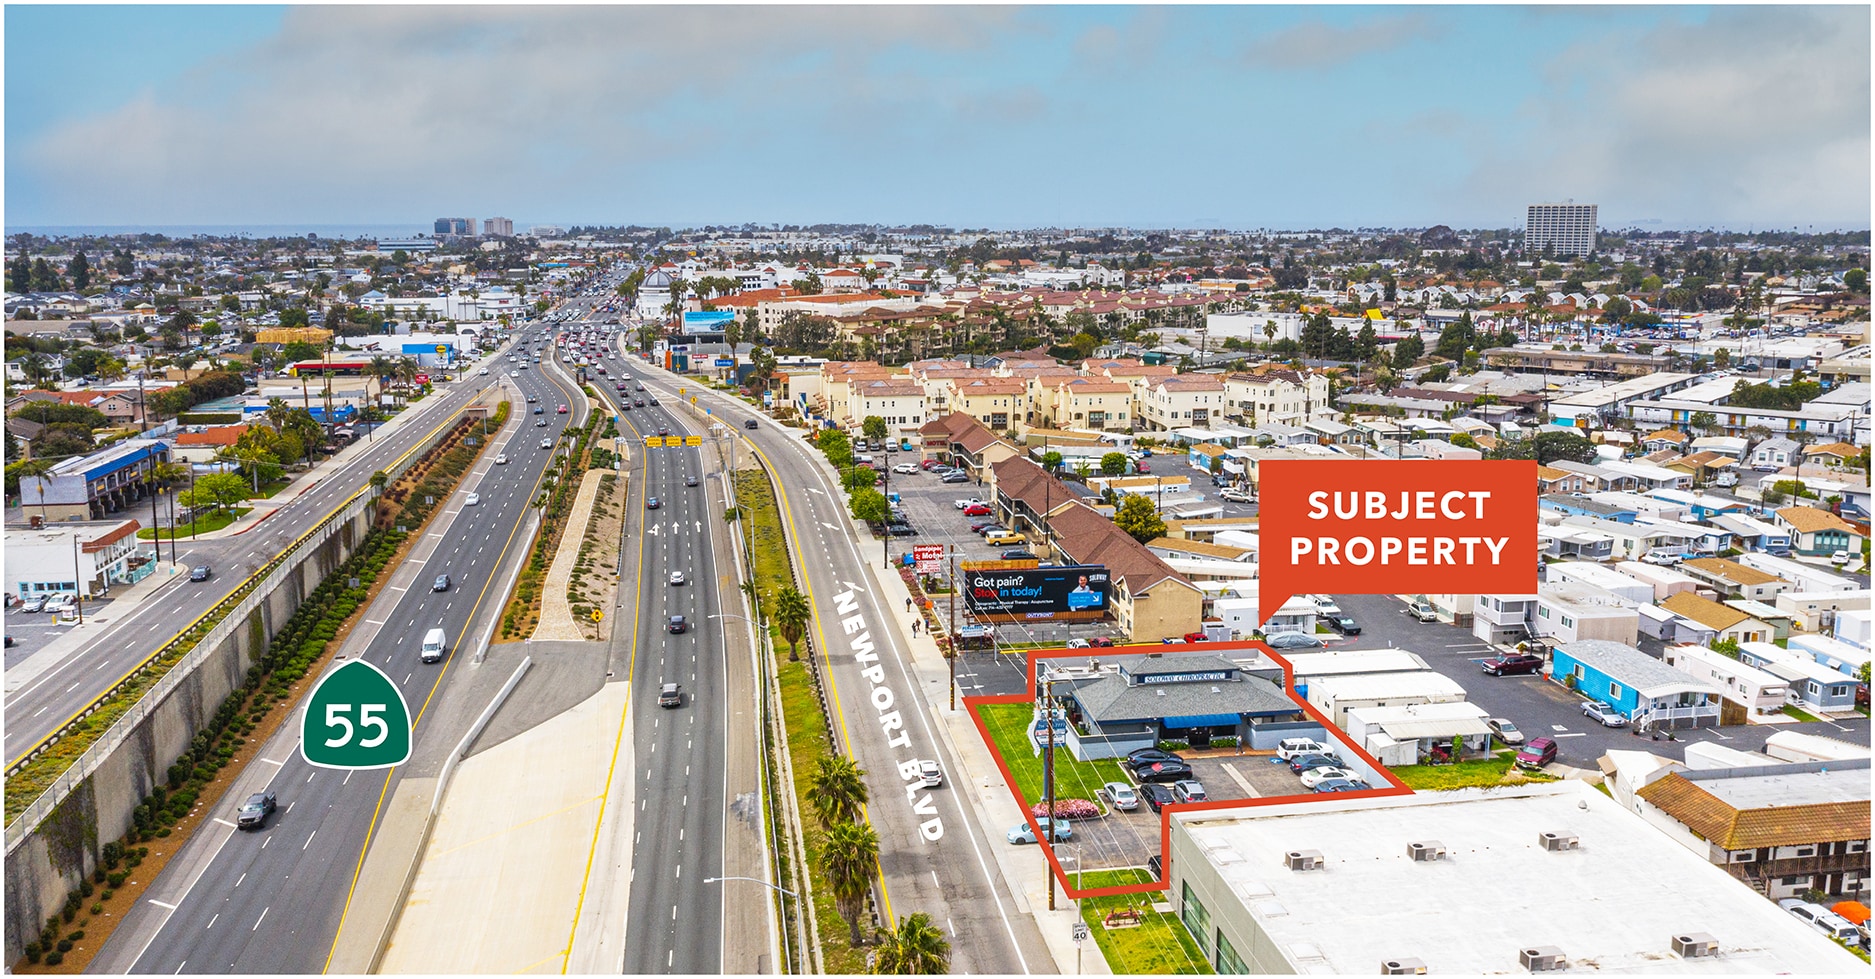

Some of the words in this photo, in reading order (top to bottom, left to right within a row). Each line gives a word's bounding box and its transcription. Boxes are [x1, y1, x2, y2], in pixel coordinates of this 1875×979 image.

[974, 577, 995, 587] Got
[996, 576, 1024, 588] pain?
[974, 588, 998, 599] Stop
[1000, 587, 1009, 597] in
[1011, 586, 1042, 598] today!
[1144, 675, 1174, 683] SOLOWAY
[1176, 672, 1225, 682] CHIROPRACTIC
[1073, 931, 1086, 940] 40
